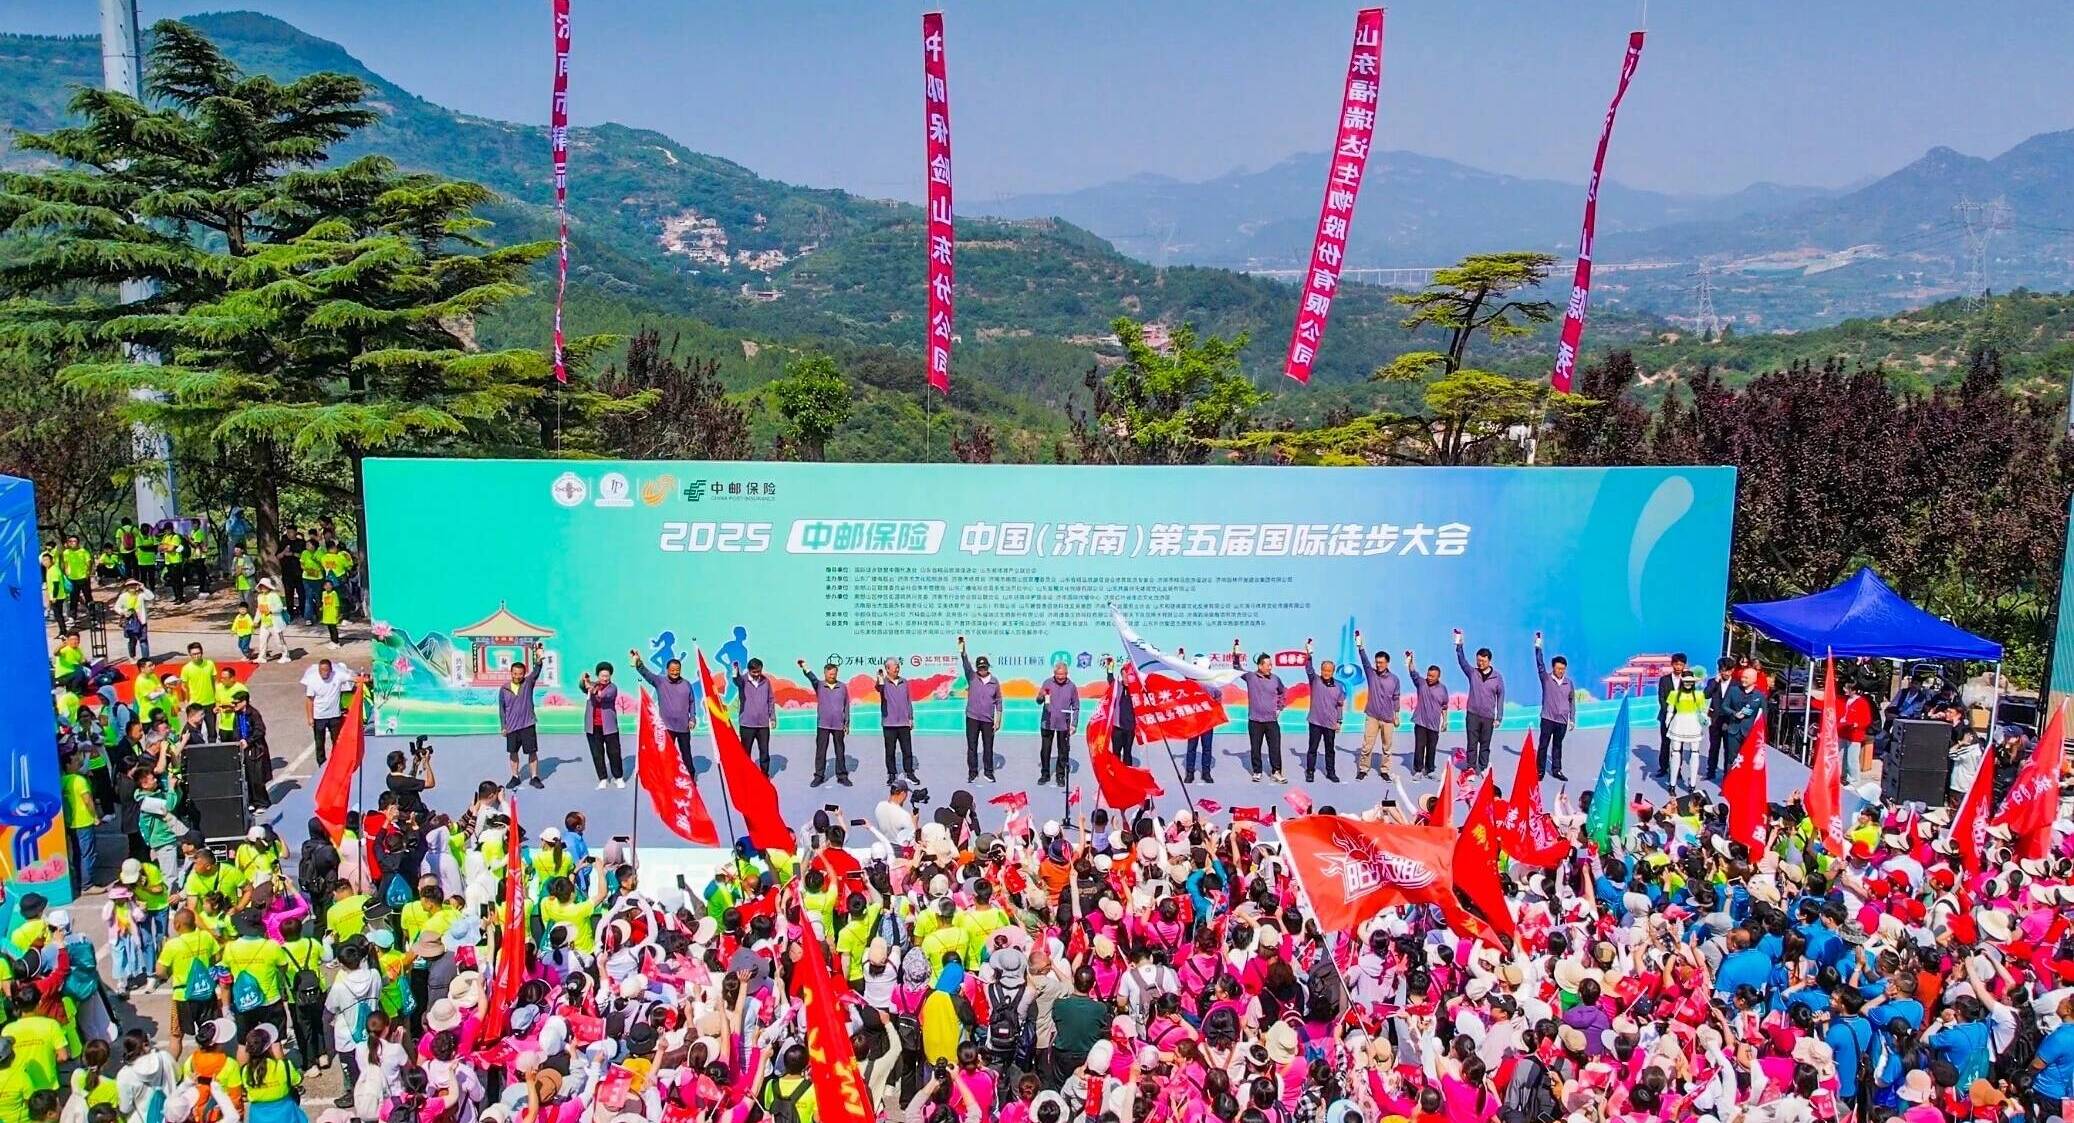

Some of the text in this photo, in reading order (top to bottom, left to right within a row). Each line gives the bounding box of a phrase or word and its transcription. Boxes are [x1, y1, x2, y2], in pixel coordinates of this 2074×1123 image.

[711, 481, 776, 495] 中邮保险
[659, 521, 1471, 557] 2025 中邮保险 中国(济南)第五届国际徒步大会
